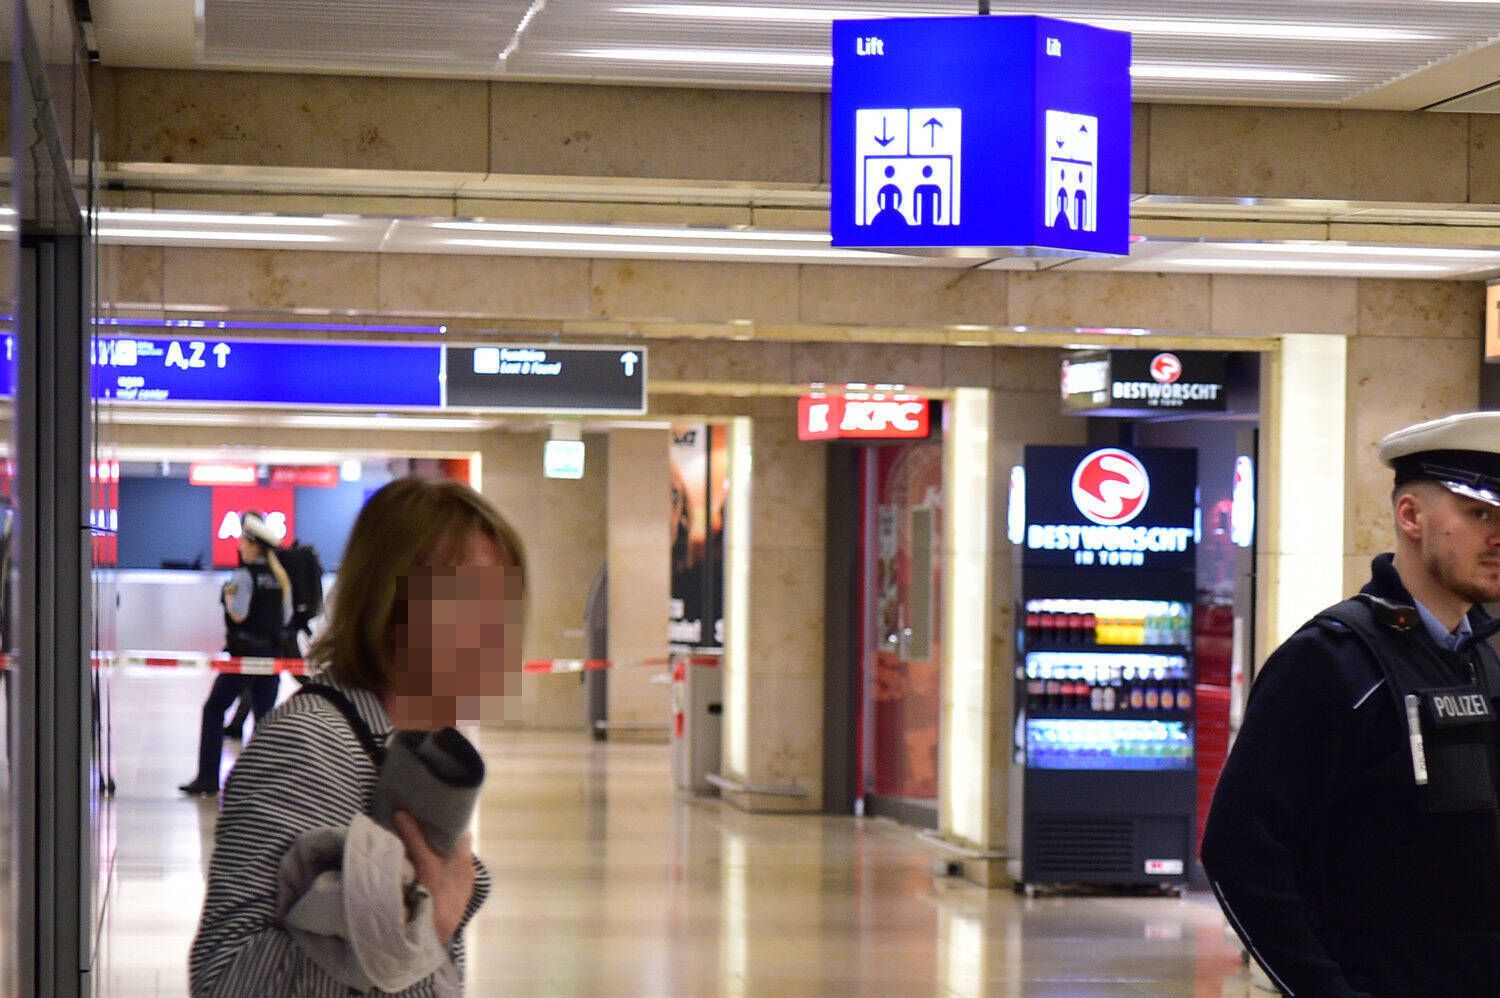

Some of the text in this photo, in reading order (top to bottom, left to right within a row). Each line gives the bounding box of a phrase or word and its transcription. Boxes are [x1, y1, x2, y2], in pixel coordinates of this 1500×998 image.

[856, 37, 884, 56] Lift
[1112, 381, 1219, 400] BESTWORSCHT
[840, 402, 923, 431] KFC
[1028, 524, 1190, 553] BESTWORSCHT
[1074, 551, 1144, 566] IN TOWN
[1433, 694, 1489, 718] POLIZEI
